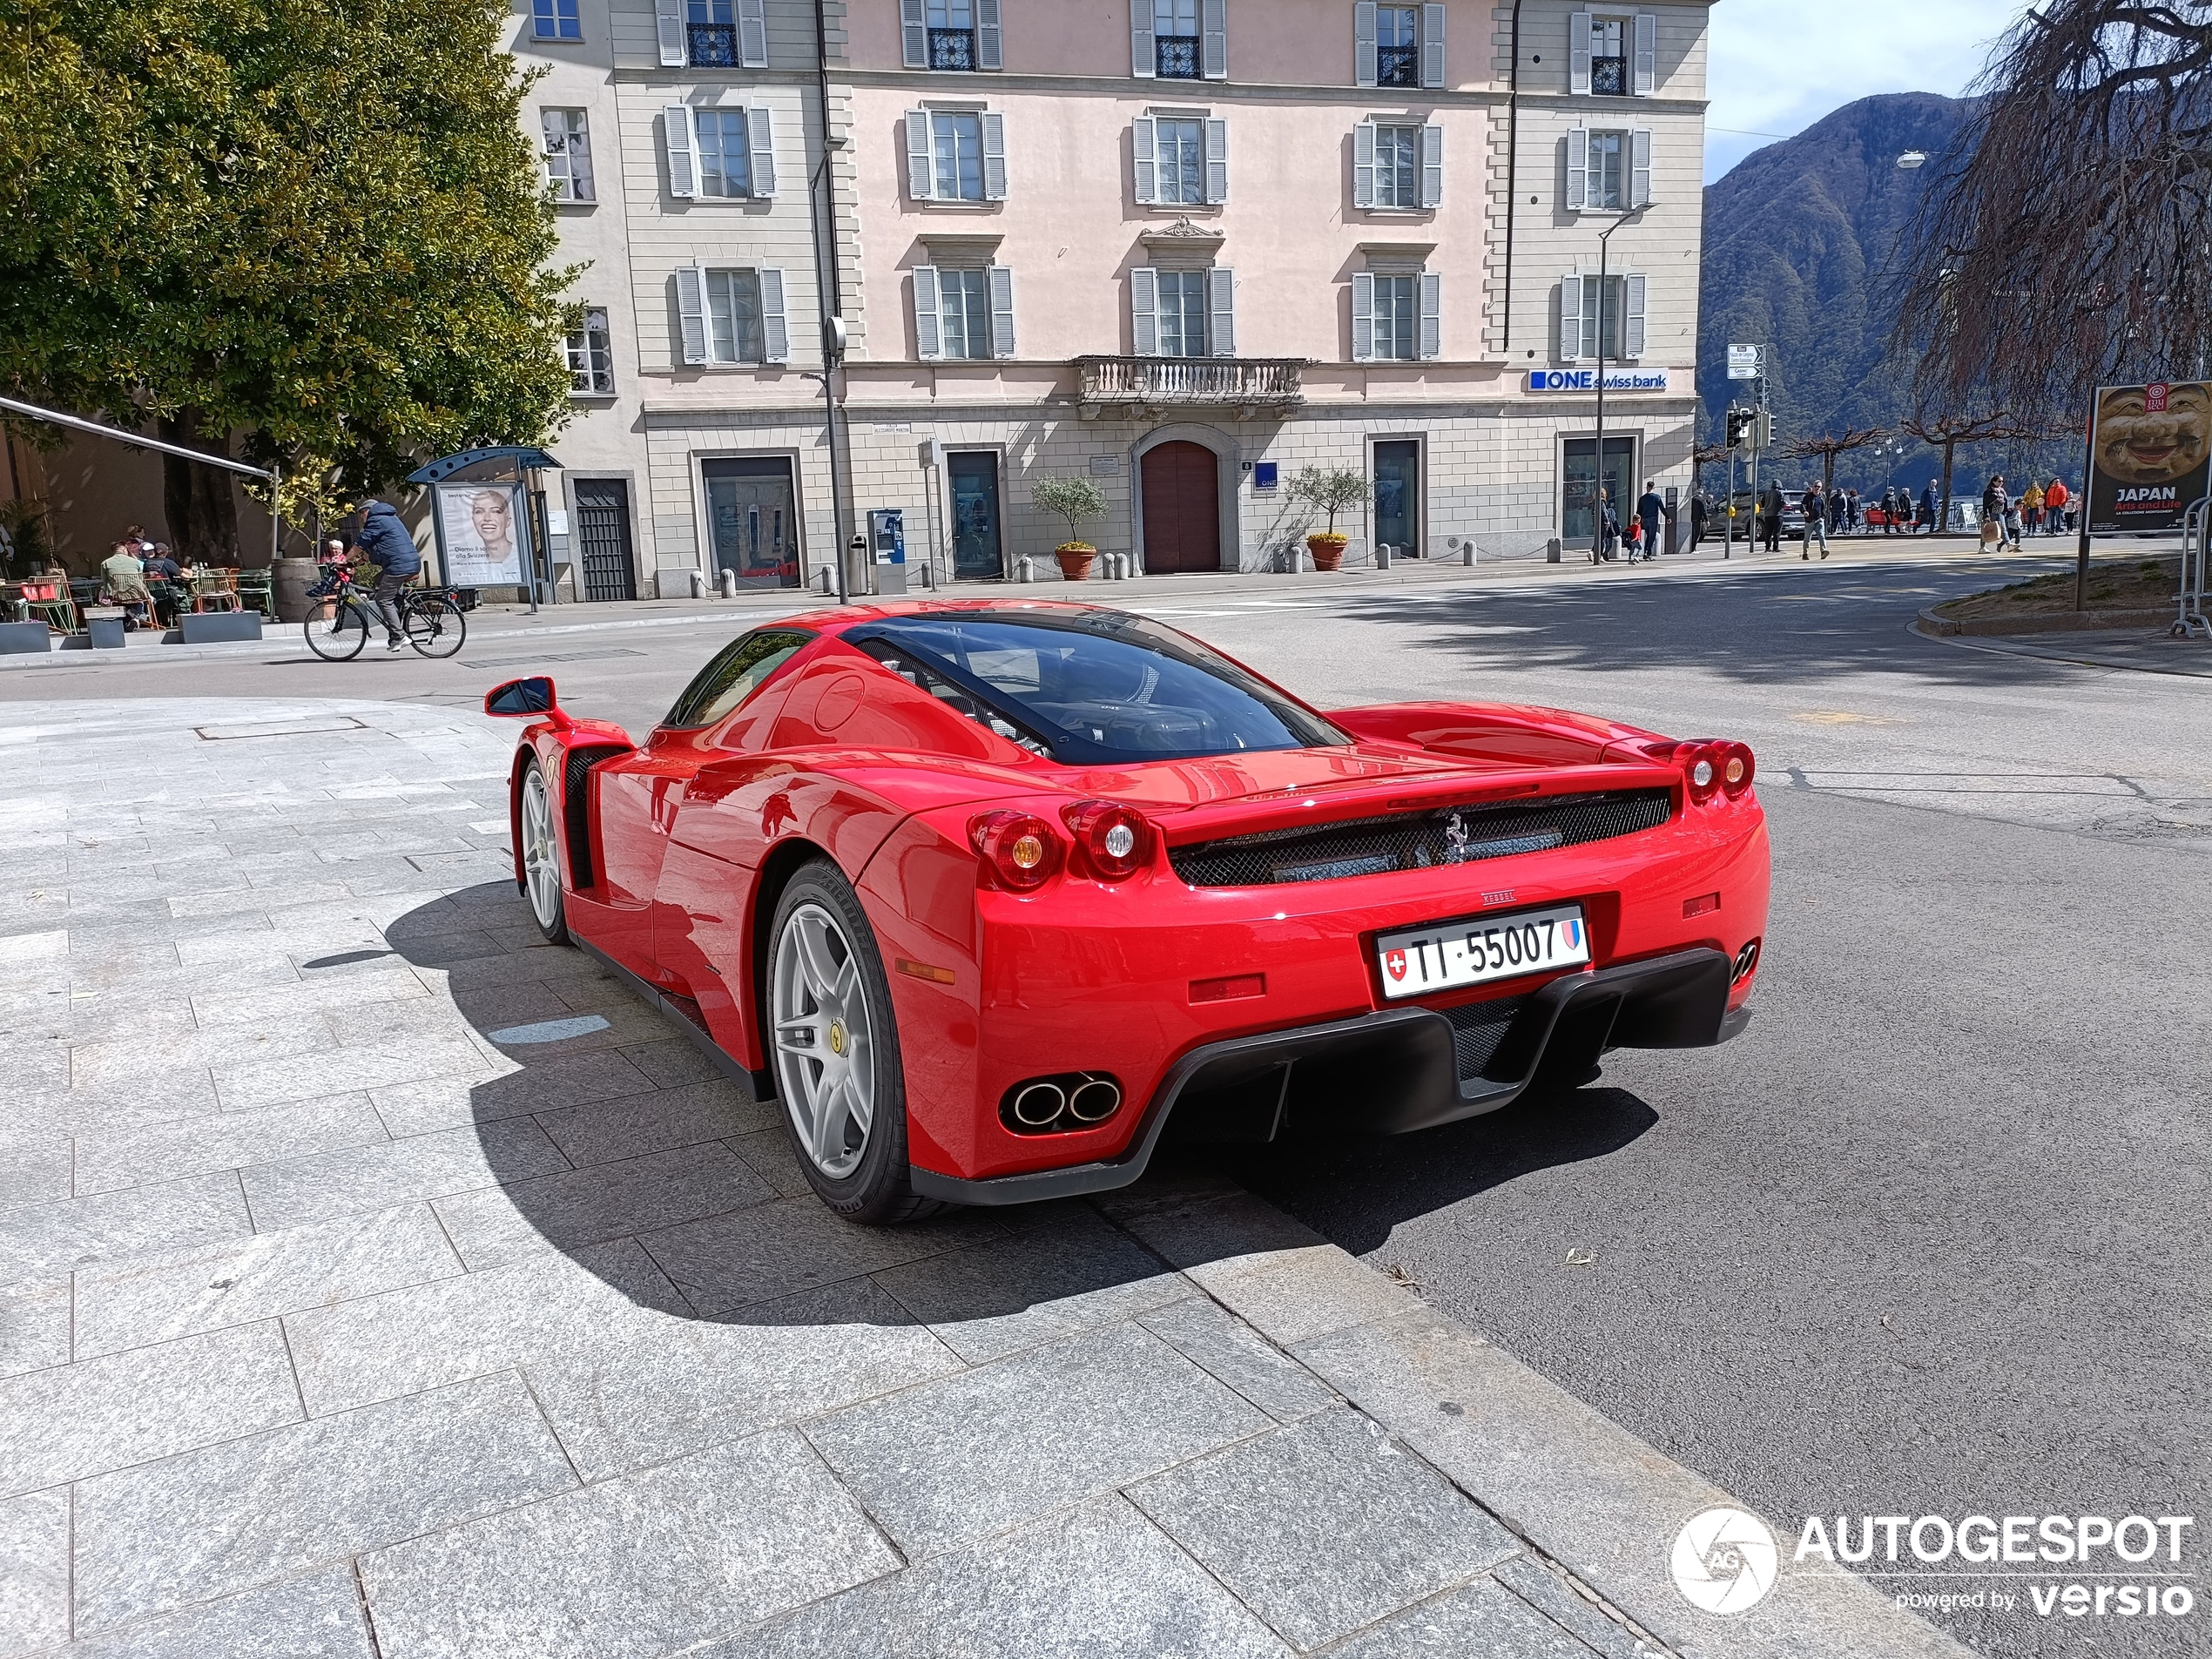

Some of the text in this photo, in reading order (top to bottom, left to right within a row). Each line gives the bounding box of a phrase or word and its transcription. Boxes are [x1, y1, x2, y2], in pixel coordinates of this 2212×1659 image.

[1547, 372, 1666, 388] ONE swiss bank
[2117, 487, 2176, 502] JAPAN
[2114, 500, 2182, 510] Arts and Life
[1483, 892, 1514, 903] KESSEL
